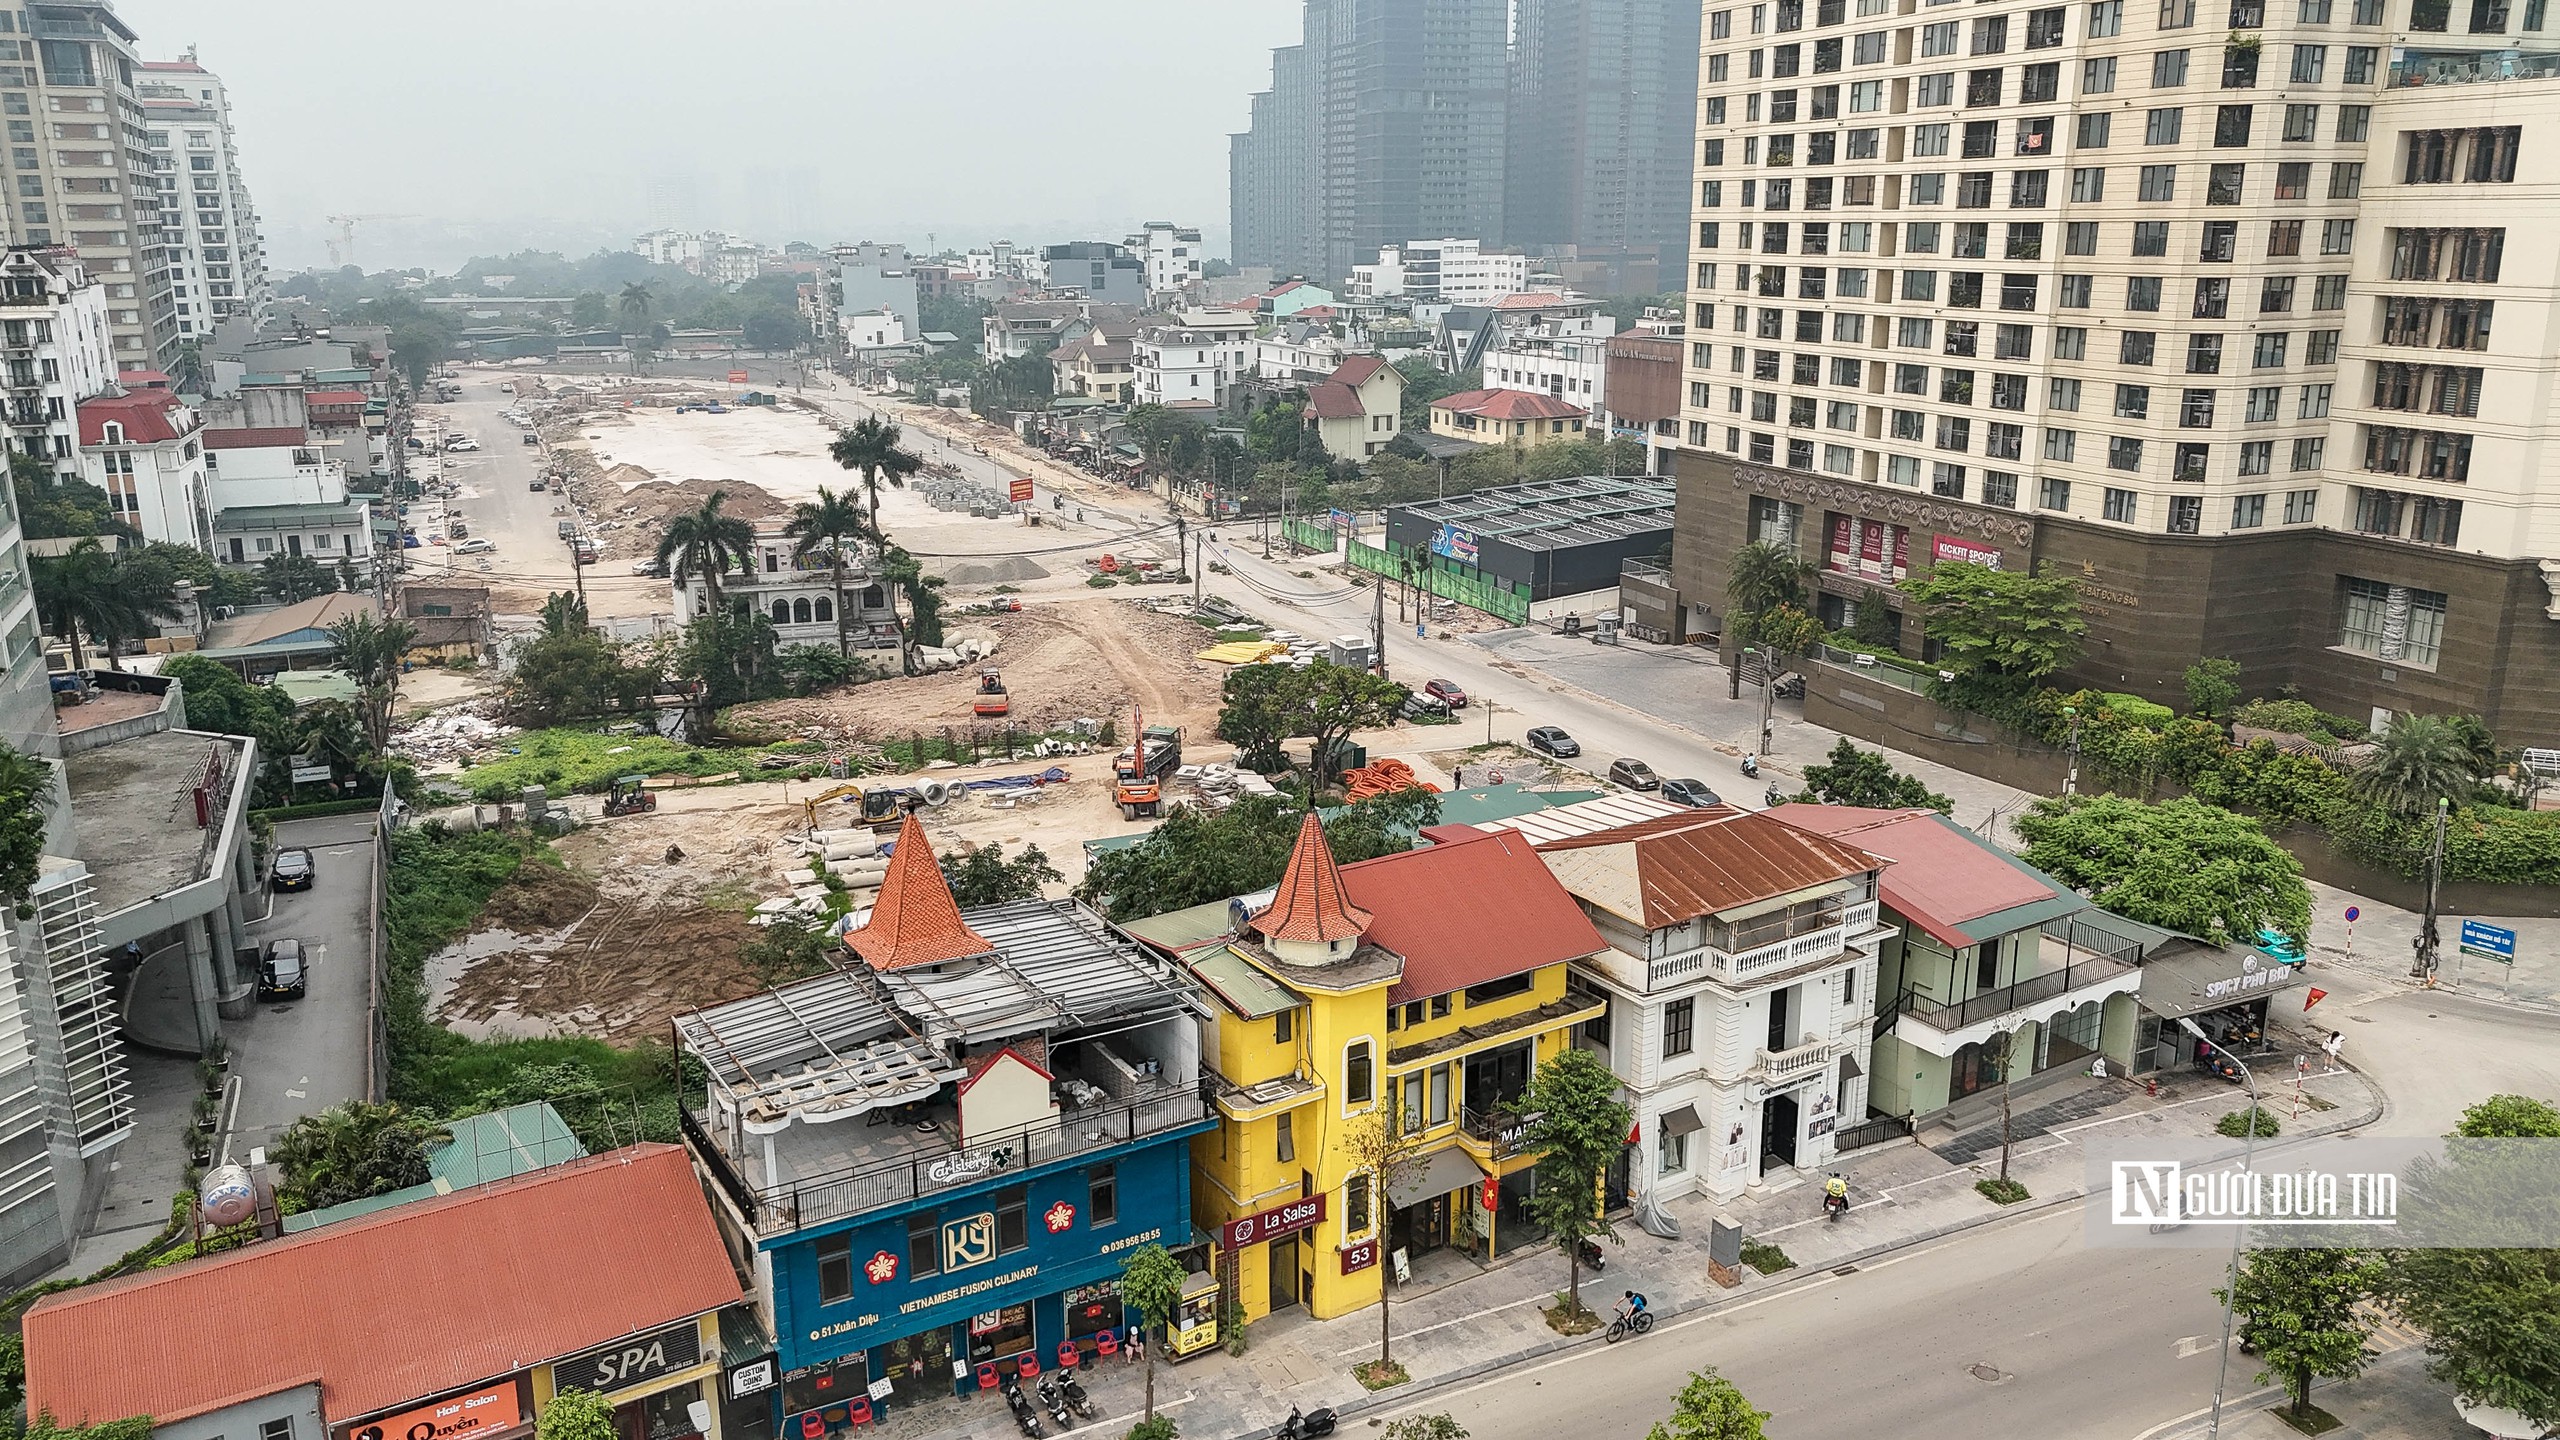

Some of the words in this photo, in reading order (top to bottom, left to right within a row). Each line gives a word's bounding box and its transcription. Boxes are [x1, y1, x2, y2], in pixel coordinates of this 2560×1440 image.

[1938, 542, 1968, 557] KICKFIT
[2205, 976, 2241, 998] SPICY
[2268, 964, 2292, 983] BAY
[929, 1151, 990, 1182] Carlsberg
[1264, 1214, 1280, 1230] La
[1283, 1202, 1316, 1224] Salsa
[1110, 1238, 1125, 1252] 036
[1125, 1234, 1140, 1248] 956
[1140, 1231, 1150, 1244] 58
[1150, 1228, 1161, 1241] 55
[1351, 1247, 1370, 1265] 53
[899, 1289, 960, 1315] VIETNAMESE
[960, 1280, 993, 1297] FUSION
[994, 1265, 1039, 1287] CULINARY
[821, 1326, 833, 1338] 51
[833, 1318, 857, 1335] Xuân
[858, 1312, 880, 1329] Diệu
[593, 1340, 666, 1387] SPA
[737, 1364, 766, 1380] CUSTOM
[742, 1374, 763, 1387] COINS
[436, 1403, 461, 1418] Hair
[464, 1393, 498, 1409] Salon
[406, 1416, 479, 1440] Quyền
